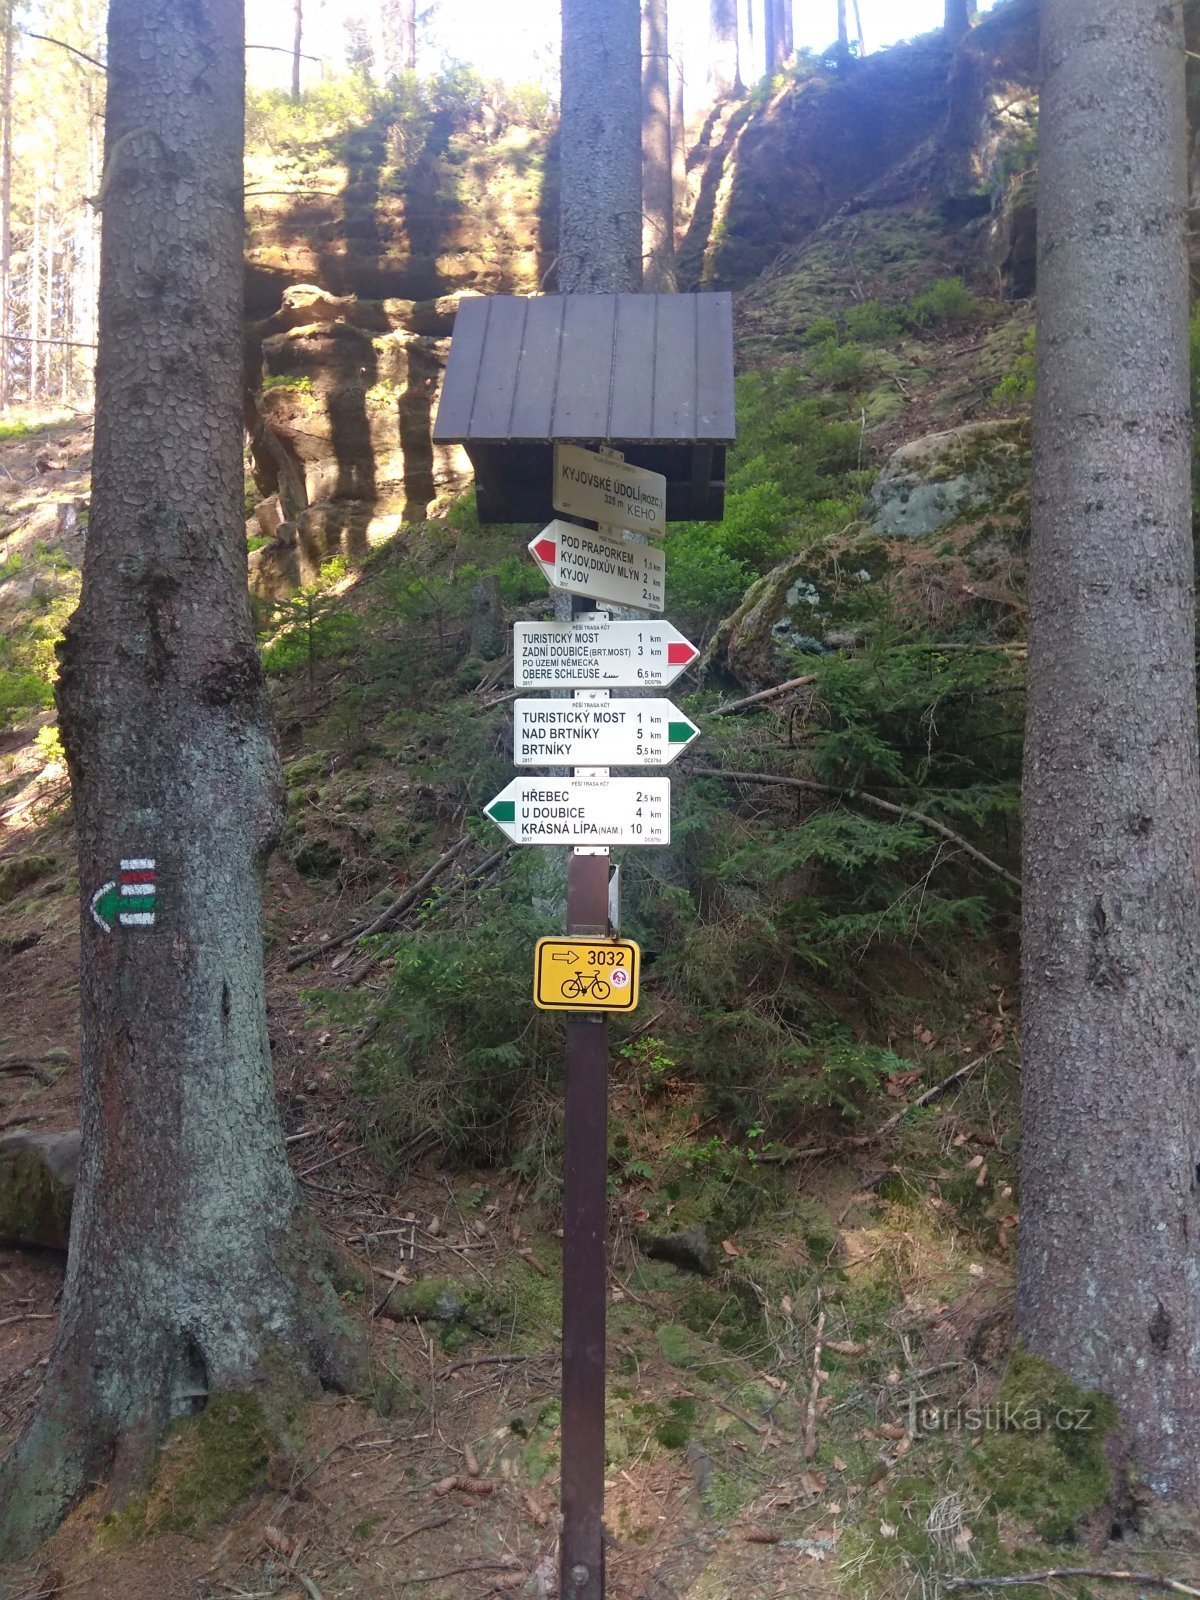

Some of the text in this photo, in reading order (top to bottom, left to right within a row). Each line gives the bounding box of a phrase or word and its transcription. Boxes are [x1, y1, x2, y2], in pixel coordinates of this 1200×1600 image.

[562, 464, 612, 492] KYJOVSKÉ
[613, 480, 641, 501] ÚDOLÍ
[604, 494, 624, 508] 328 m
[627, 503, 656, 521] KEHO
[561, 534, 580, 549] POD
[581, 540, 634, 564] PRAPORKEM
[653, 564, 662, 572] km
[560, 550, 662, 587] KYJOV,DIXŮV MLÝN 2 km
[560, 566, 661, 602] KYJOV 2,5 km
[522, 631, 573, 643] TURISTICKÝ
[574, 633, 599, 643] MOST
[637, 633, 643, 642] 1
[522, 644, 549, 657] ZADNÍ
[550, 646, 589, 657] DOUBICE
[637, 646, 643, 656] 3
[650, 648, 662, 656] km
[522, 657, 599, 667] PO ÚZEMÍ NĚMECKA
[522, 669, 552, 679] OBERE
[554, 668, 600, 679] SCHLEUSE
[637, 669, 649, 679] 6,5
[522, 709, 590, 723] TURISTICKÝ
[593, 712, 626, 723] MOST
[637, 712, 642, 723] 1
[522, 728, 547, 739] NAD
[549, 725, 600, 739] BRTNÍKY
[636, 728, 643, 739] 5
[522, 741, 572, 755] BRTNÍKY
[636, 744, 649, 756] 5,5
[522, 788, 570, 802] HŘEBEC
[636, 791, 649, 803] 2,5
[522, 807, 530, 818] U
[533, 807, 585, 818] DOUBICE
[635, 807, 642, 818] 4
[521, 820, 570, 834] KRÁSNÁ
[573, 820, 598, 834] LÍPA
[630, 823, 643, 834] 10
[587, 950, 624, 966] 3032
